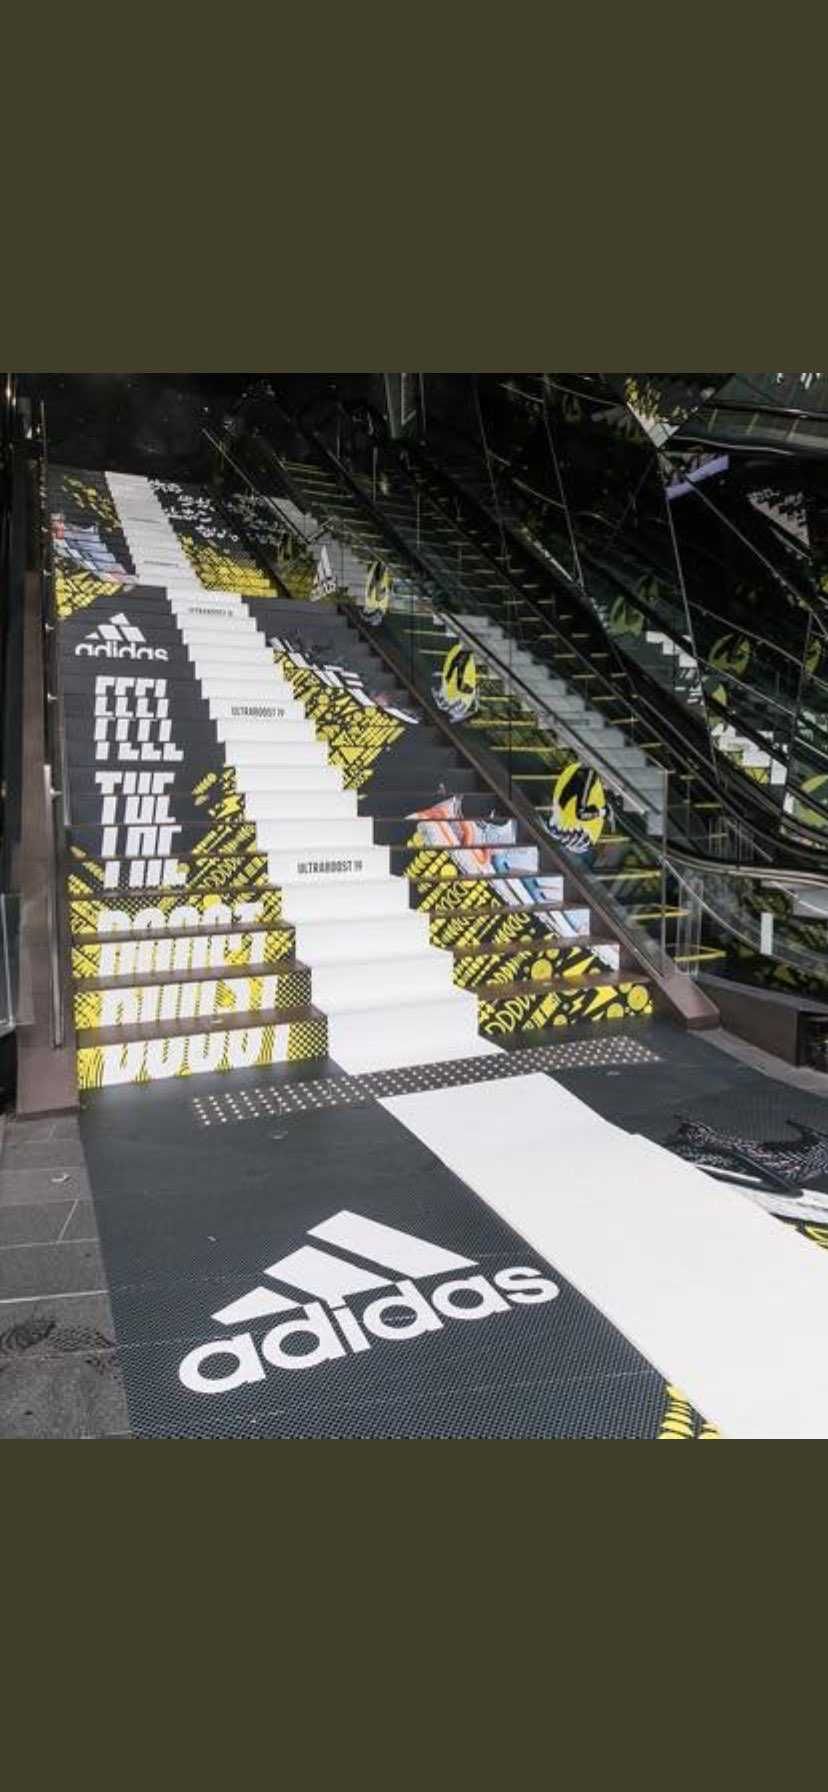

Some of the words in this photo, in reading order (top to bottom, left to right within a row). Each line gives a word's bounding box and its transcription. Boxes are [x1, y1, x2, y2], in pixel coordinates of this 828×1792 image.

[74, 639, 169, 662] adidas
[94, 675, 185, 762] FEEL
[95, 771, 187, 890] THE
[297, 860, 352, 874] ULTRABOOST
[97, 901, 288, 1085] BOOST
[178, 1266, 560, 1394] adidas
